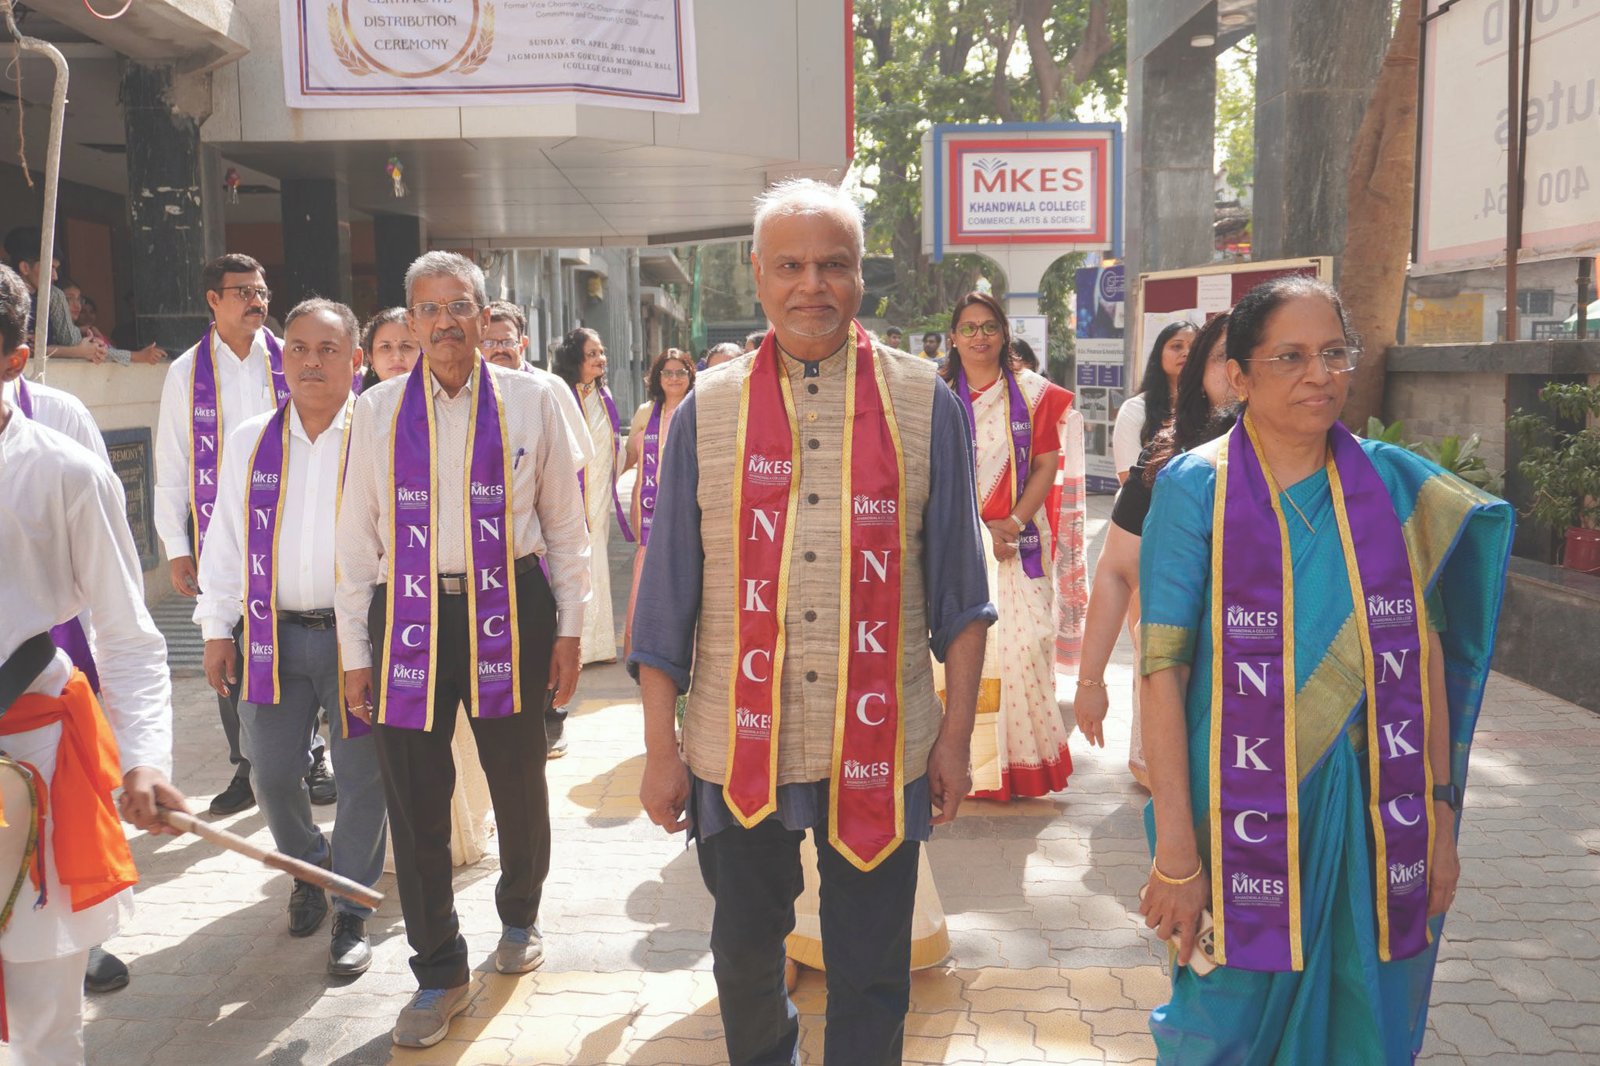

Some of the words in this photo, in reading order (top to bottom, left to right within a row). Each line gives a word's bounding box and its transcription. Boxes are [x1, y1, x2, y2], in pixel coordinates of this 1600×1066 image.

[363, 14, 457, 28] DISTRIBUTION
[374, 38, 449, 51] CEREMONY
[973, 165, 1084, 193] MKES
[969, 200, 1036, 213] KHANDWALA
[1039, 200, 1086, 212] COLLEGE
[1019, 216, 1041, 224] ARTS
[1050, 215, 1086, 224] SCIENCE
[194, 407, 216, 417] MKES
[109, 446, 138, 461] EREMONY
[748, 459, 792, 475] MKES
[252, 472, 279, 484] MKES
[398, 489, 428, 502] MKES
[471, 483, 504, 496] MKES
[854, 499, 896, 515] MKES
[1369, 598, 1413, 616] MKES
[1227, 611, 1278, 627] MKES
[251, 643, 273, 655] MKES
[393, 665, 425, 680] MKES
[478, 661, 512, 675] MKES
[845, 762, 889, 779] MKES
[1390, 859, 1425, 884] MKES
[1232, 878, 1284, 895] MKES
